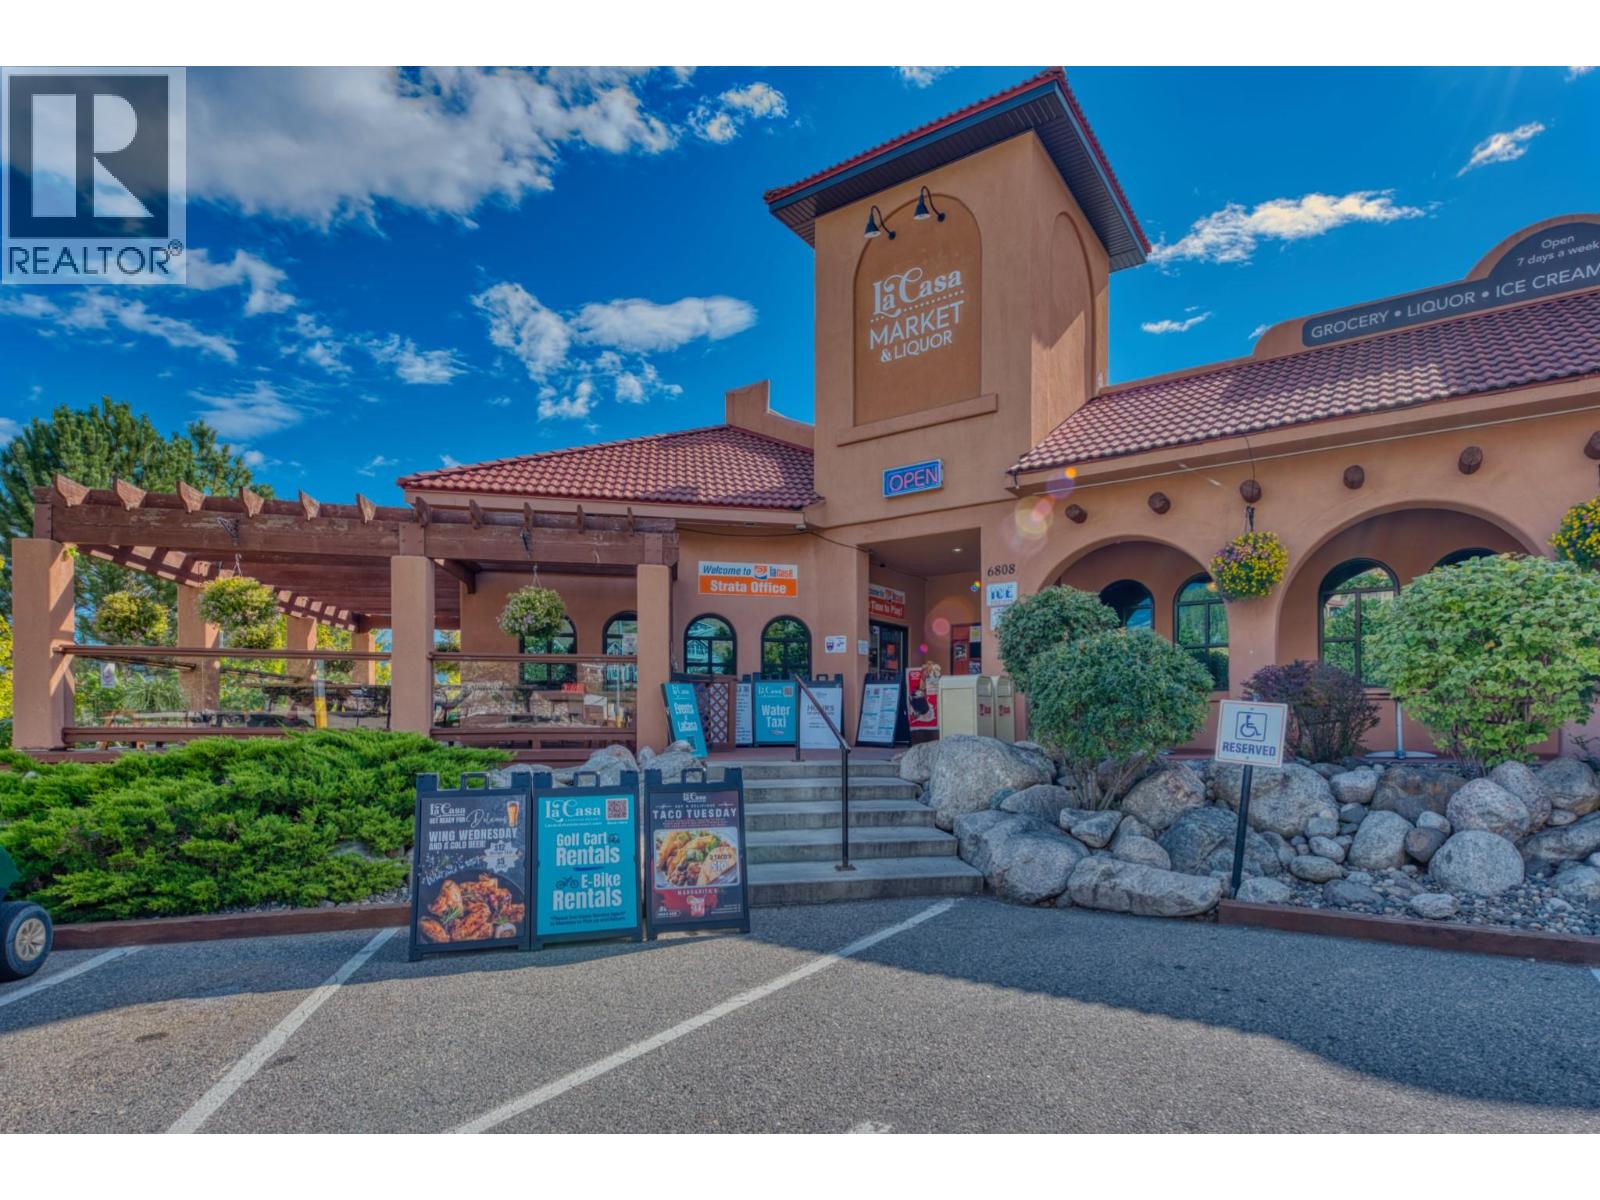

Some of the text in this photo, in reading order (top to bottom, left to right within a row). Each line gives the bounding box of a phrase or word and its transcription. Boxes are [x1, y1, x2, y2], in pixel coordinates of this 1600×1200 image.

[1541, 236, 1575, 250] Open
[1517, 240, 1599, 266] 7 days a week
[1311, 310, 1390, 339] GROCERY
[1407, 291, 1476, 318] LIQUOR
[1496, 279, 1527, 298] ICE
[869, 300, 965, 351] MARKET
[880, 330, 953, 363] & LIQUOR
[889, 466, 938, 491] OPEN
[703, 565, 741, 576] Welcome
[742, 567, 751, 576] to
[987, 563, 1016, 576] 6808
[710, 579, 787, 594] Strata Office
[761, 703, 791, 716] Water
[766, 716, 786, 728] Taxi
[1222, 741, 1276, 756] RESERVED
[653, 808, 737, 819] TACO TUESDAY
[429, 828, 518, 842] WING WEDNESDAY
[556, 831, 607, 847] Golf Cart
[429, 841, 442, 851] AND
[450, 841, 467, 850] COLD
[556, 845, 620, 867] Rentals
[581, 872, 621, 889] E-Bike
[553, 887, 622, 911] Rentals
